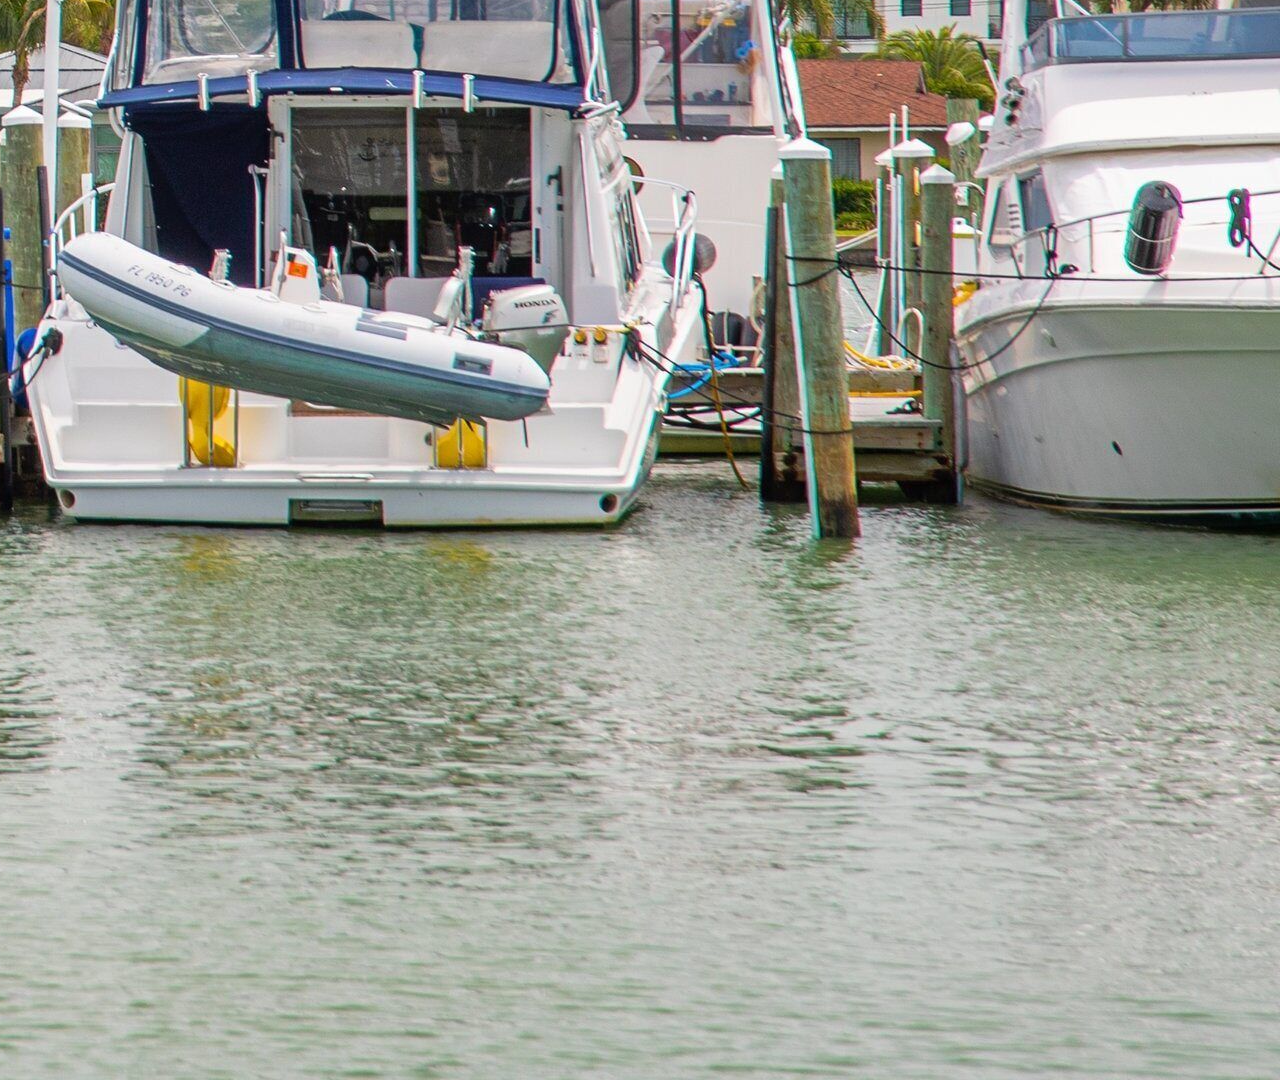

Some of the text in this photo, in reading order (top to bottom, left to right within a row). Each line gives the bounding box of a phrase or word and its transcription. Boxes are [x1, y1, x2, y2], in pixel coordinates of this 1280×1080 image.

[127, 264, 144, 276] FL
[172, 283, 192, 297] PG
[513, 299, 557, 309] HONDA
